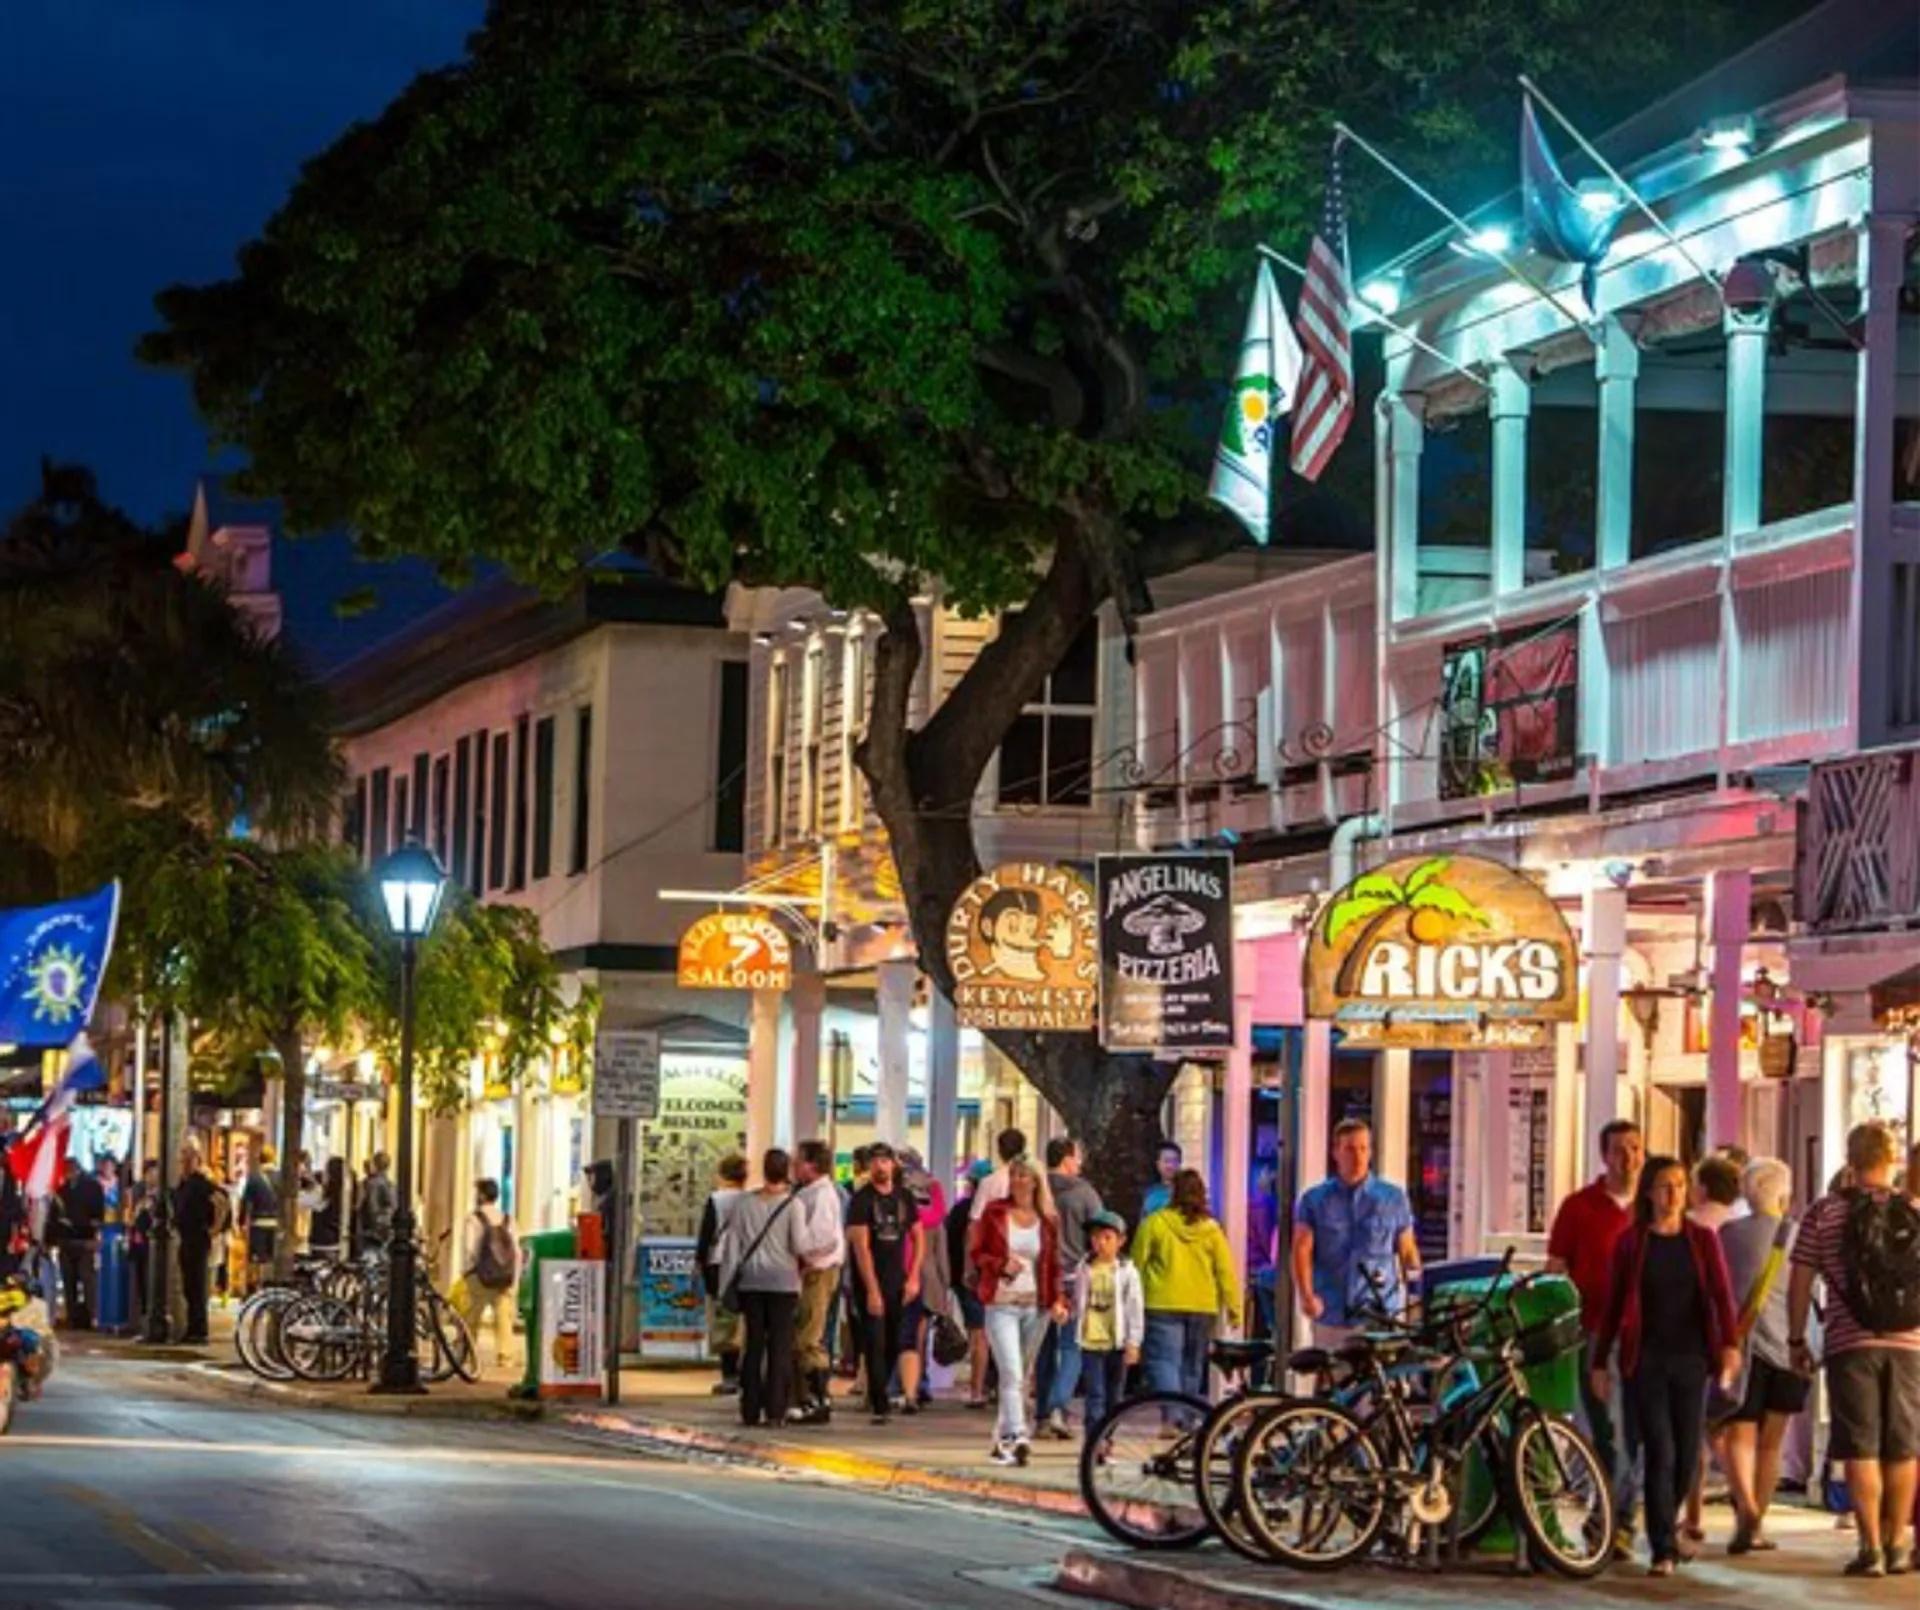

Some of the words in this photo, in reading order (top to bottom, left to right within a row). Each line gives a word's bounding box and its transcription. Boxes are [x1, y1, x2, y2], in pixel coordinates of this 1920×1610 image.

[948, 872, 1000, 982] DURTY
[728, 933, 761, 968] 7
[1117, 943, 1221, 985] PIZZERIA
[1361, 939, 1560, 999] RICK'S
[682, 967, 787, 989] SALOON
